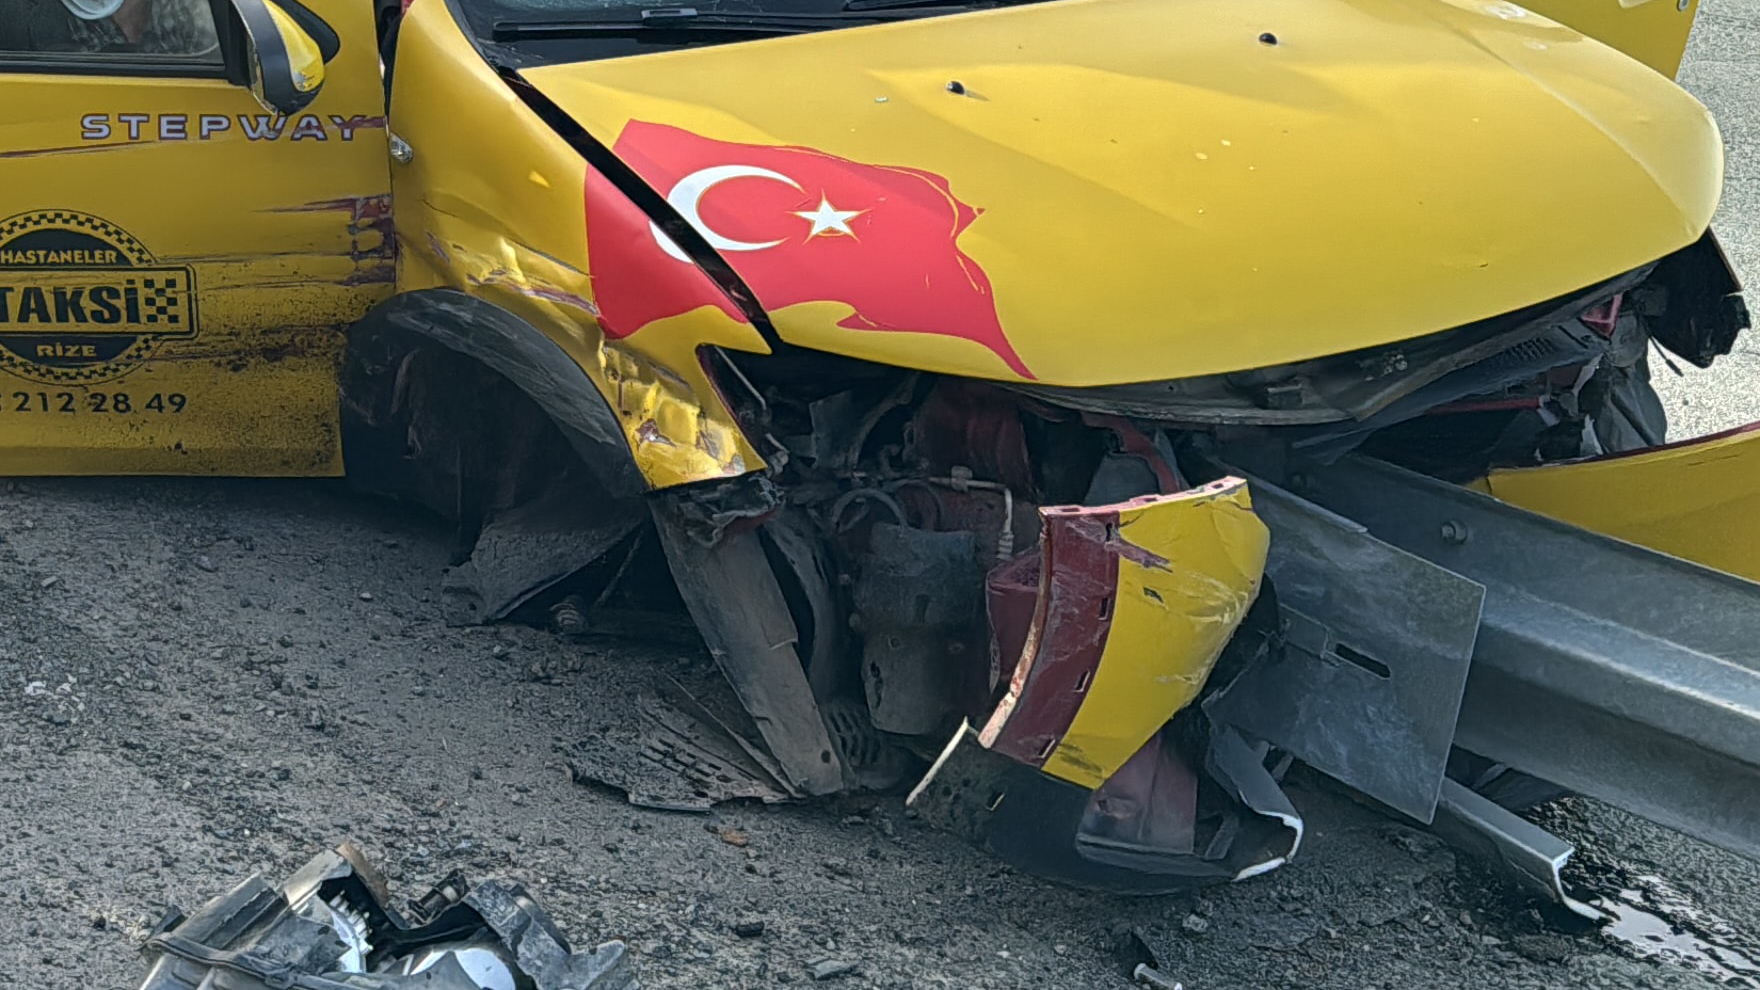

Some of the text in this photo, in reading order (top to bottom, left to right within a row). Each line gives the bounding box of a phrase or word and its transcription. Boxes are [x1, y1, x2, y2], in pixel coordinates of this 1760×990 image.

[80, 112, 366, 142] STEPWAY
[0, 249, 117, 265] HASTANELER
[36, 342, 97, 358] RİZE
[12, 391, 75, 413] 212
[145, 393, 187, 413] 49
